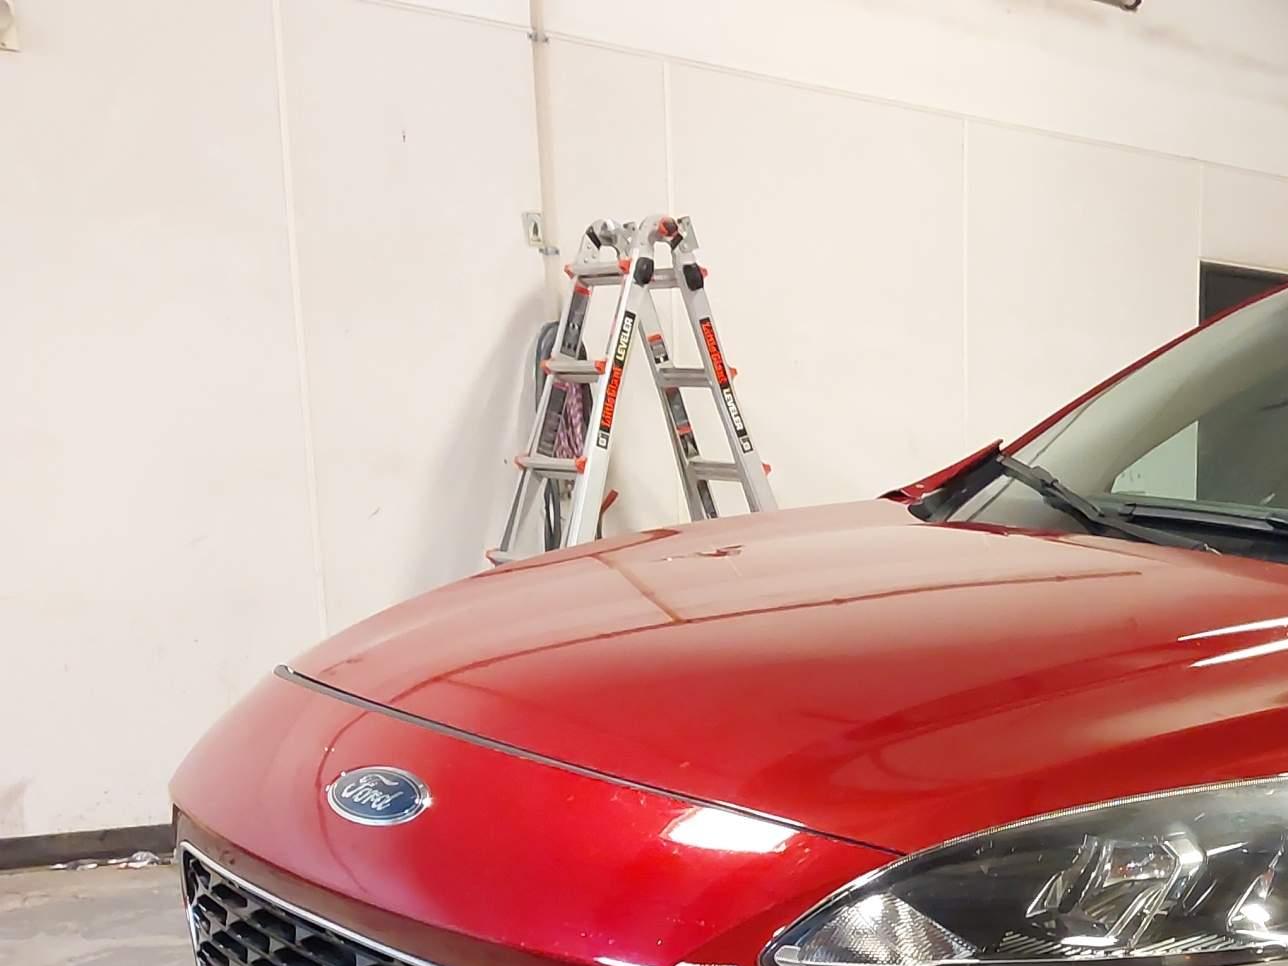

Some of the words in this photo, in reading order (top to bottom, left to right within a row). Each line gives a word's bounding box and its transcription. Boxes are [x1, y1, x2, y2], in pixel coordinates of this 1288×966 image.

[615, 317, 634, 361] LEVELER
[722, 387, 745, 431] LEVELER
[340, 773, 404, 811] Ford
